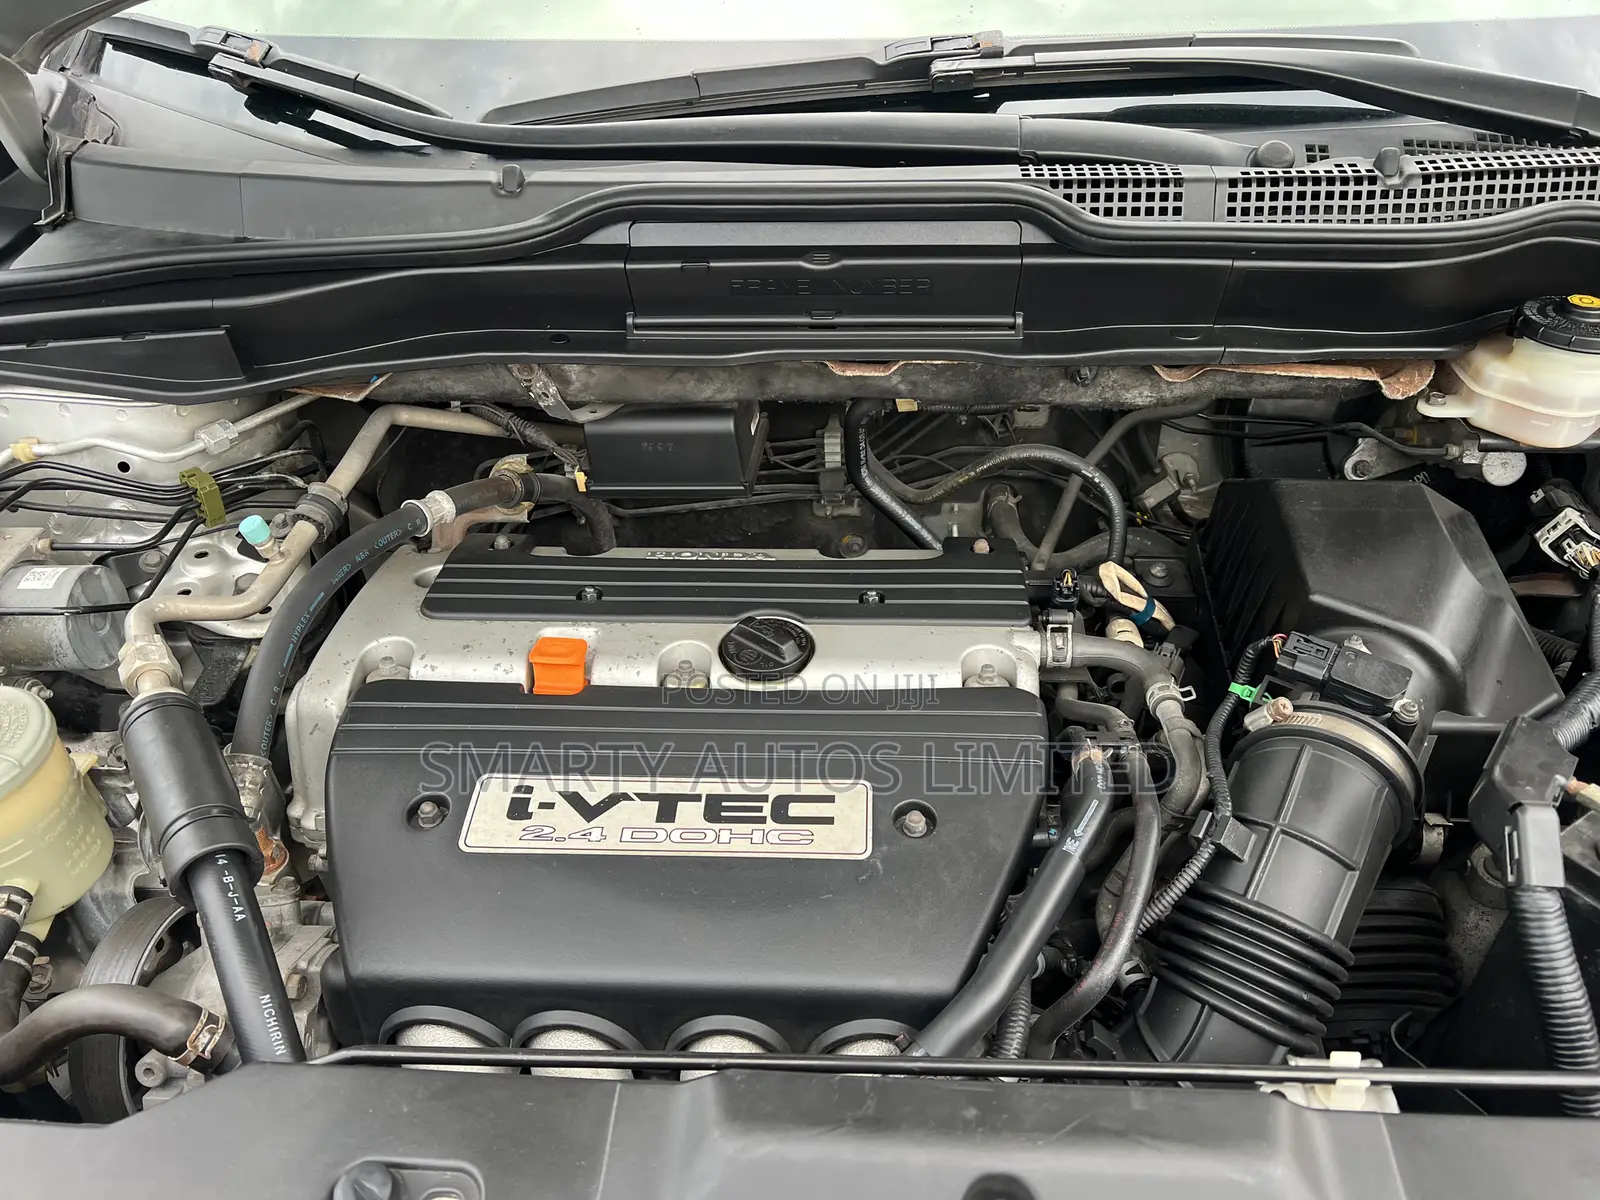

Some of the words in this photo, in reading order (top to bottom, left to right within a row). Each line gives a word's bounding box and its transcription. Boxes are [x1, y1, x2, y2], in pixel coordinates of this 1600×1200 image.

[290, 611, 311, 645] HYPLEX
[506, 785, 836, 824] i-VTEC
[518, 826, 605, 844] 2.4
[619, 827, 815, 846] DOHC
[259, 993, 288, 1056] NICHIRIN
